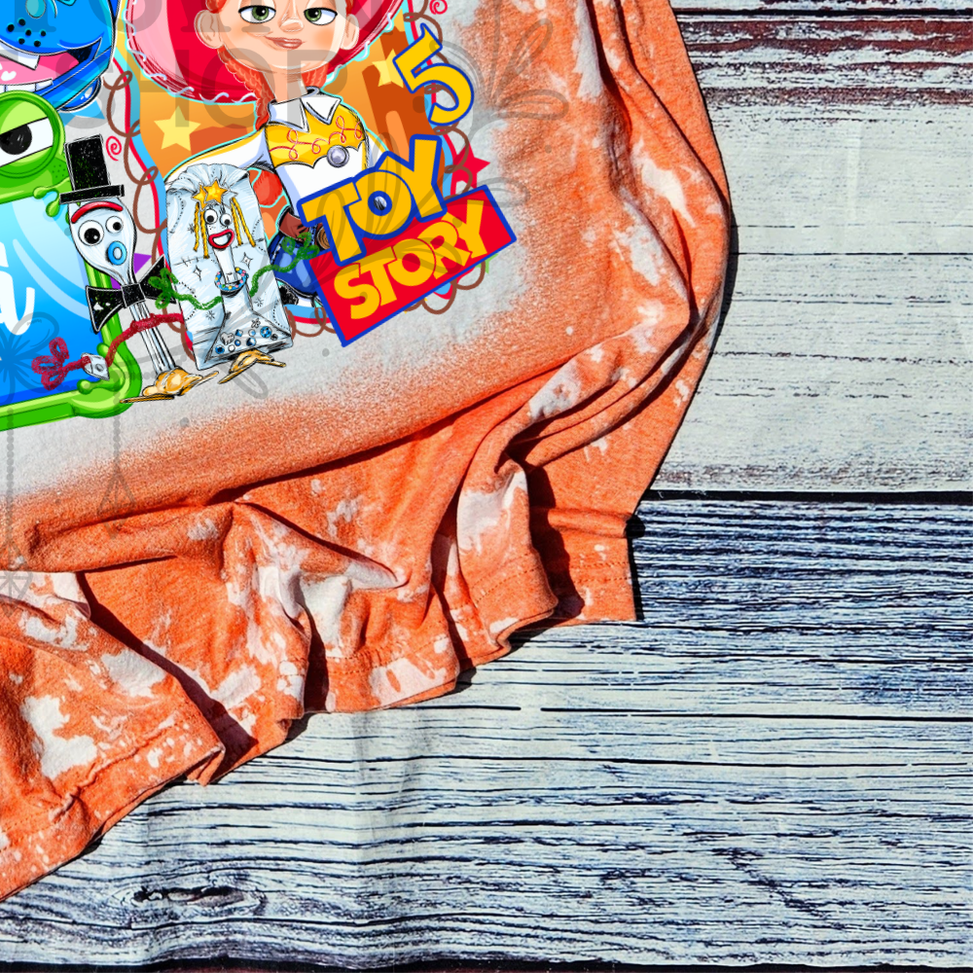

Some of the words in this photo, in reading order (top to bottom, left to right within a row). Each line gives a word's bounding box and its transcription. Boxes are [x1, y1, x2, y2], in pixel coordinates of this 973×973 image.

[392, 23, 474, 126] 5
[297, 134, 447, 266] TOY
[333, 199, 488, 320] STORY
